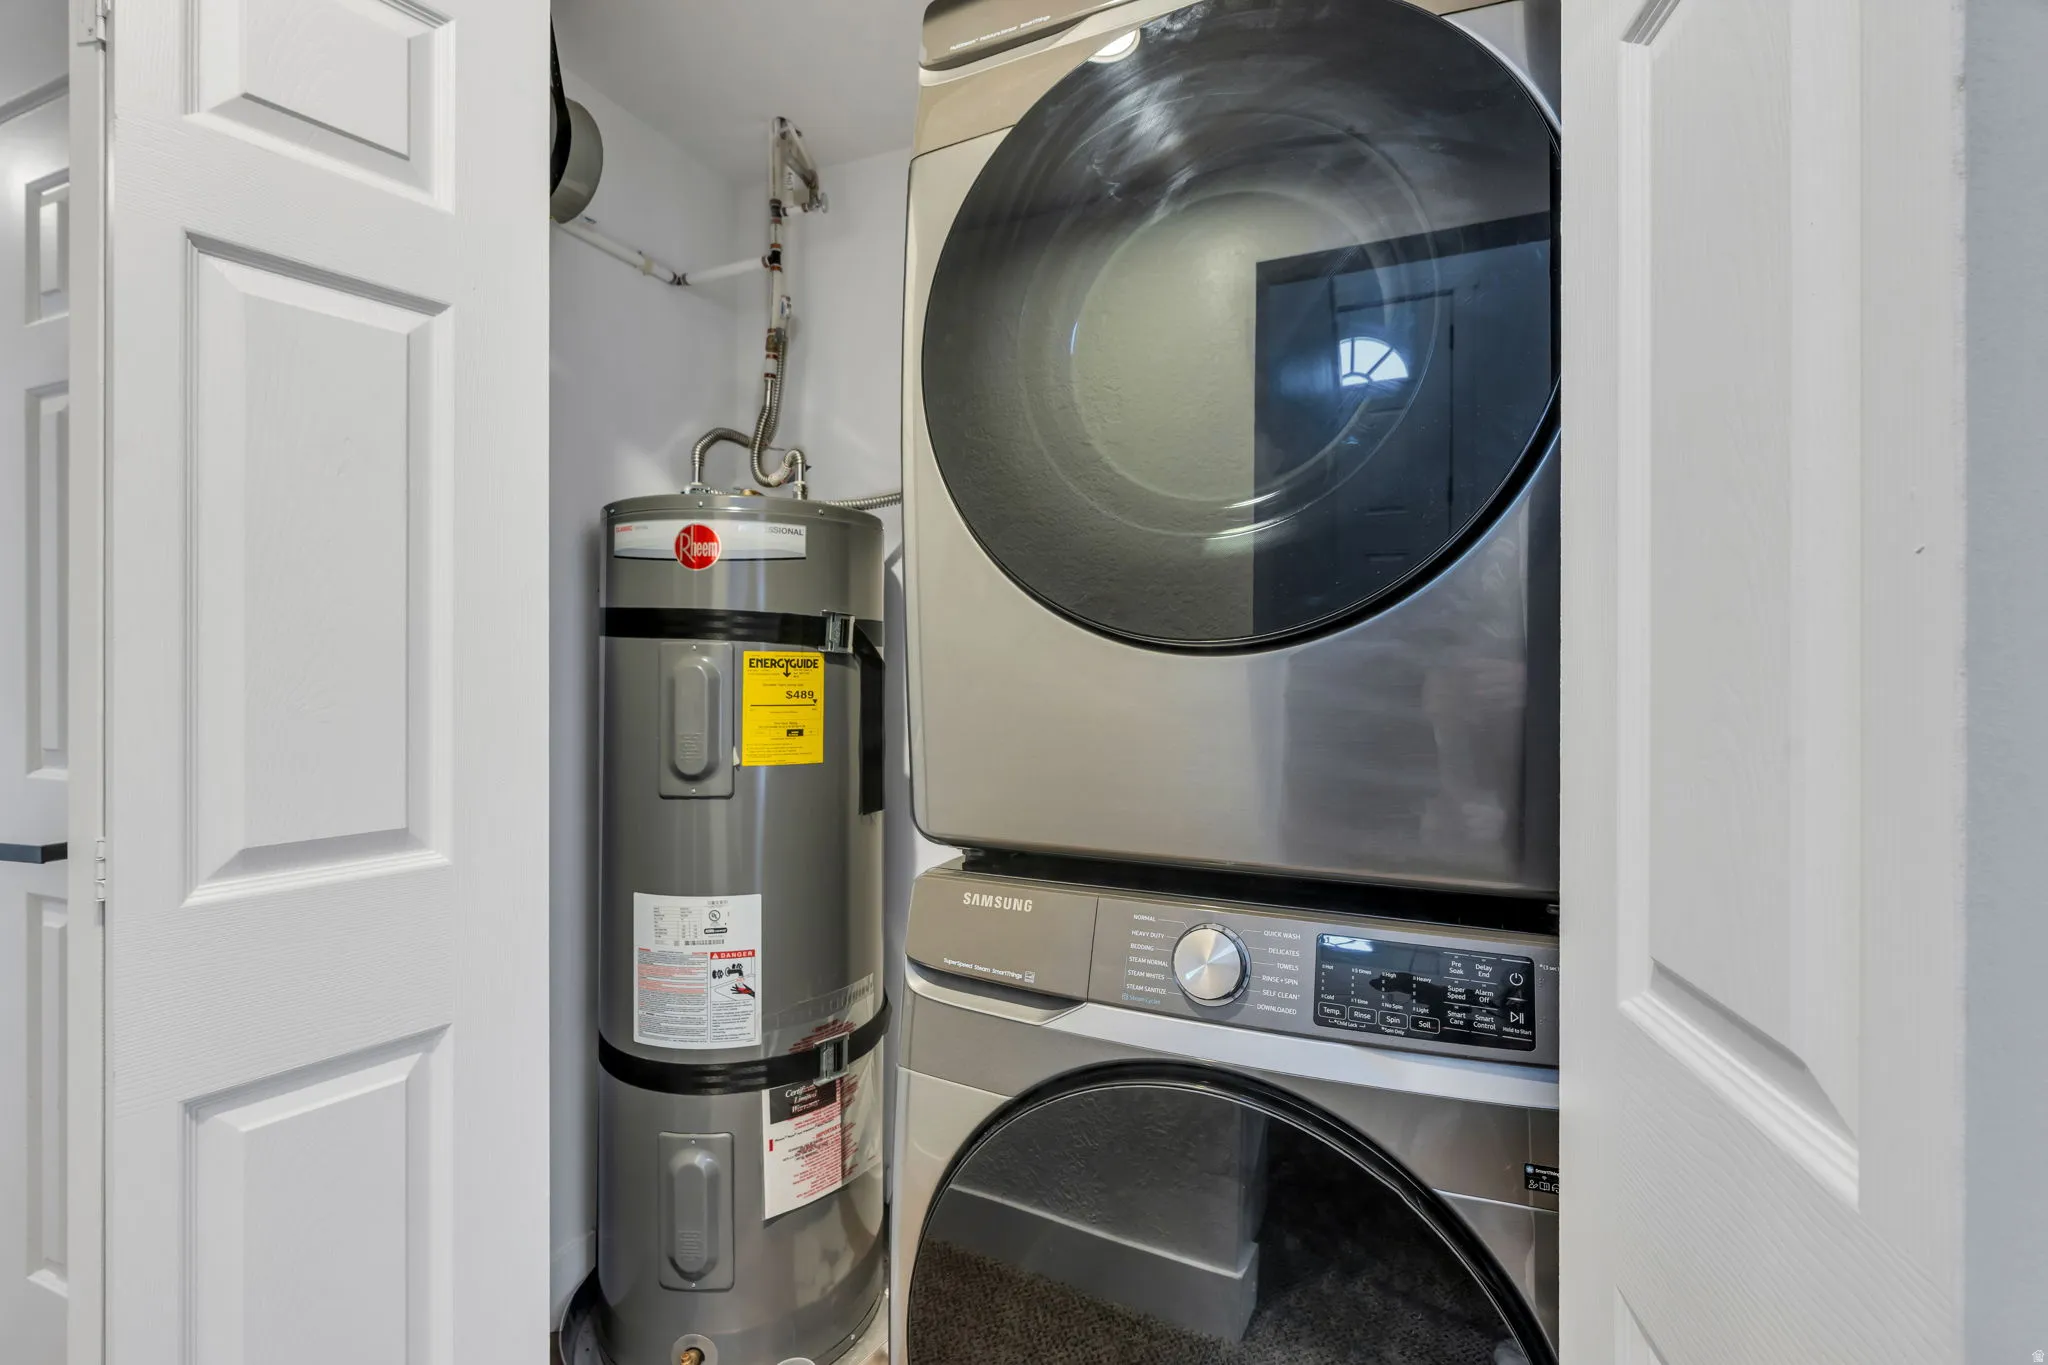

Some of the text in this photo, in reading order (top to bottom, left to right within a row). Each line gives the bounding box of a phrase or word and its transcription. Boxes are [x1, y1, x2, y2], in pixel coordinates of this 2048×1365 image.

[679, 525, 719, 563] Rheem
[749, 658, 819, 669] ENERGYGUIDE
[963, 892, 1033, 913] SAMSUNG
[1133, 914, 1156, 922] NORMAL
[1263, 930, 1301, 940] QUICK WASH
[1130, 943, 1155, 951] BEDDING
[720, 950, 753, 958] DANGER
[1268, 947, 1300, 957] DELICATES
[1147, 959, 1168, 967] NORMAL
[1277, 962, 1299, 971] TOWELS
[1451, 960, 1462, 968] Pre
[1475, 963, 1493, 972] Delay
[974, 964, 991, 973] Steam
[1449, 967, 1464, 975] Soak
[1128, 969, 1165, 980] STEAM WHITES
[1262, 974, 1280, 983] RINSE
[1284, 977, 1298, 986] SPIN
[1416, 976, 1432, 984] Heavy
[1126, 983, 1167, 995] STEAM SANITIZE
[1262, 989, 1277, 997] SELF
[1447, 985, 1465, 993] Super
[1474, 988, 1494, 997] Alarm
[1447, 992, 1466, 1000] Speed
[1256, 1003, 1297, 1015] DOWNLOADED
[1353, 1010, 1371, 1020] Rinse
[1447, 1010, 1466, 1019] Smart
[1474, 1014, 1494, 1023] Smart
[1386, 1015, 1401, 1024] Spin
[1449, 1018, 1464, 1026] Care
[1418, 1020, 1431, 1029] Soil
[1473, 1021, 1496, 1031] Control
[1520, 1028, 1532, 1036] Start
